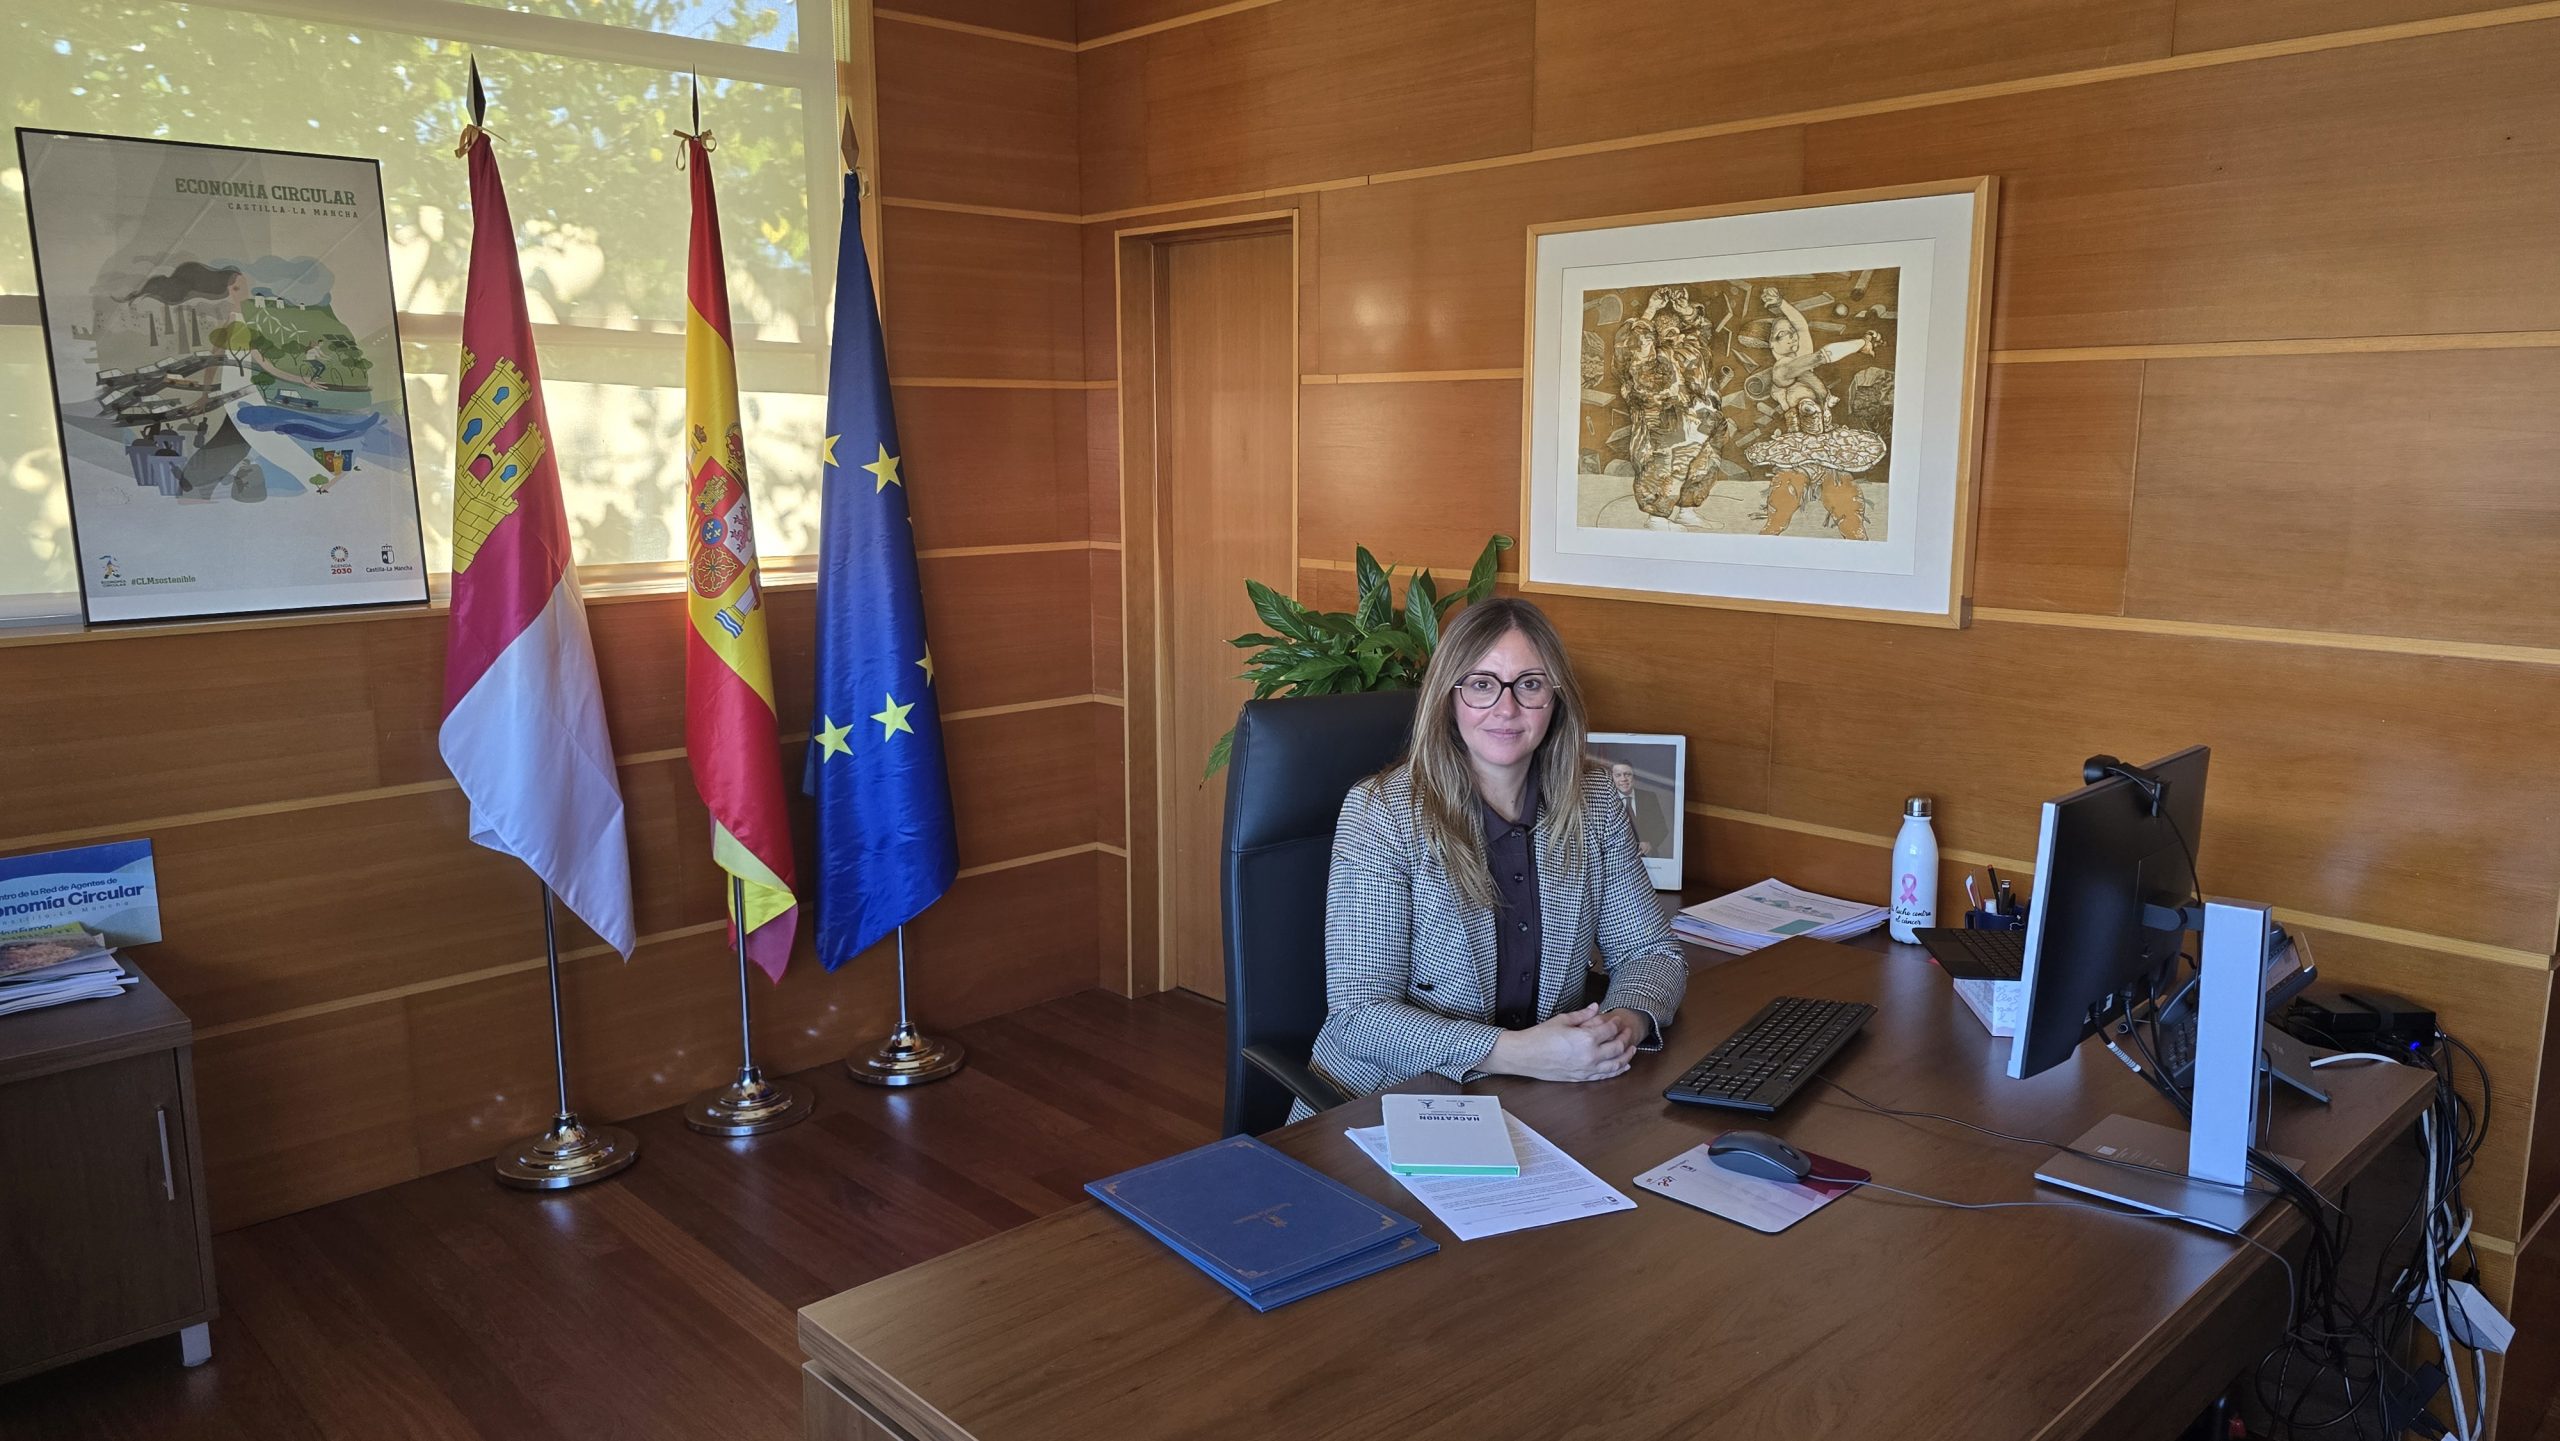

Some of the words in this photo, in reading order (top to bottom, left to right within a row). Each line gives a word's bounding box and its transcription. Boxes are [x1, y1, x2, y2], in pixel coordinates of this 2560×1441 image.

[175, 177, 268, 200] ECONOMÍA
[271, 185, 357, 206] CIRCULAR
[227, 202, 306, 215] CASTILLA-LA
[313, 208, 359, 219] MANCHA
[131, 575, 196, 586] #CLMsostenible
[331, 567, 353, 575] 2030
[18, 890, 29, 898] de
[39, 886, 57, 895] Red
[58, 884, 69, 892] de
[70, 880, 105, 891] Agentes
[106, 877, 118, 885] de
[68, 885, 145, 906] Circular
